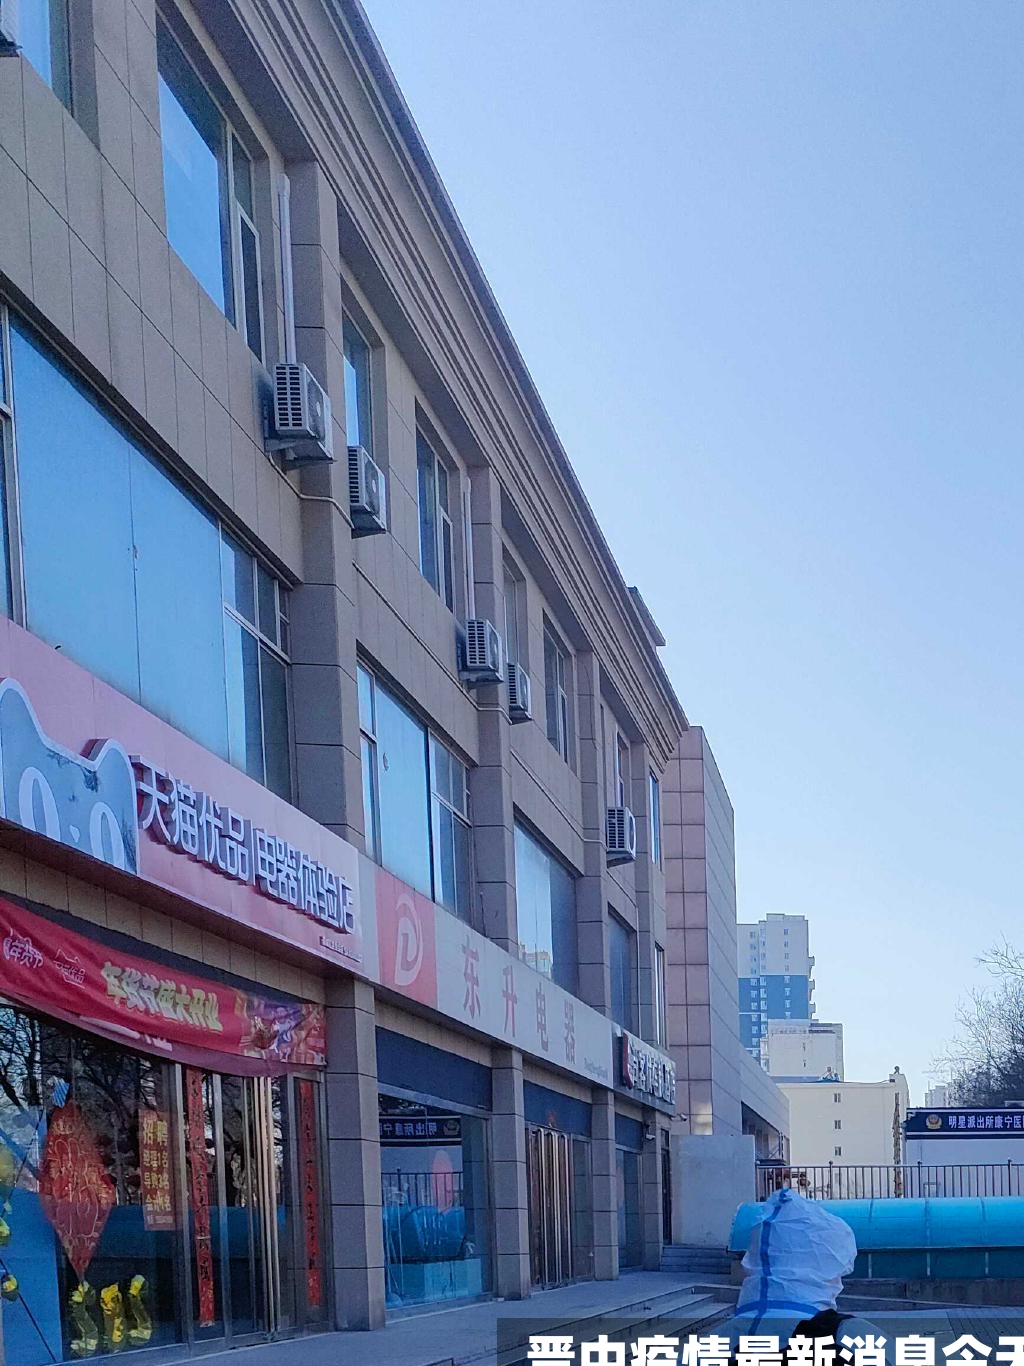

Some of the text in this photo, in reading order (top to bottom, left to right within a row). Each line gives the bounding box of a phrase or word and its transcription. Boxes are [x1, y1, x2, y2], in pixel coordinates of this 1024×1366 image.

[137, 767, 357, 934] 天猫优品 电器体验店
[461, 936, 576, 1064] 东升电器
[143, 1117, 169, 1146] 招聘
